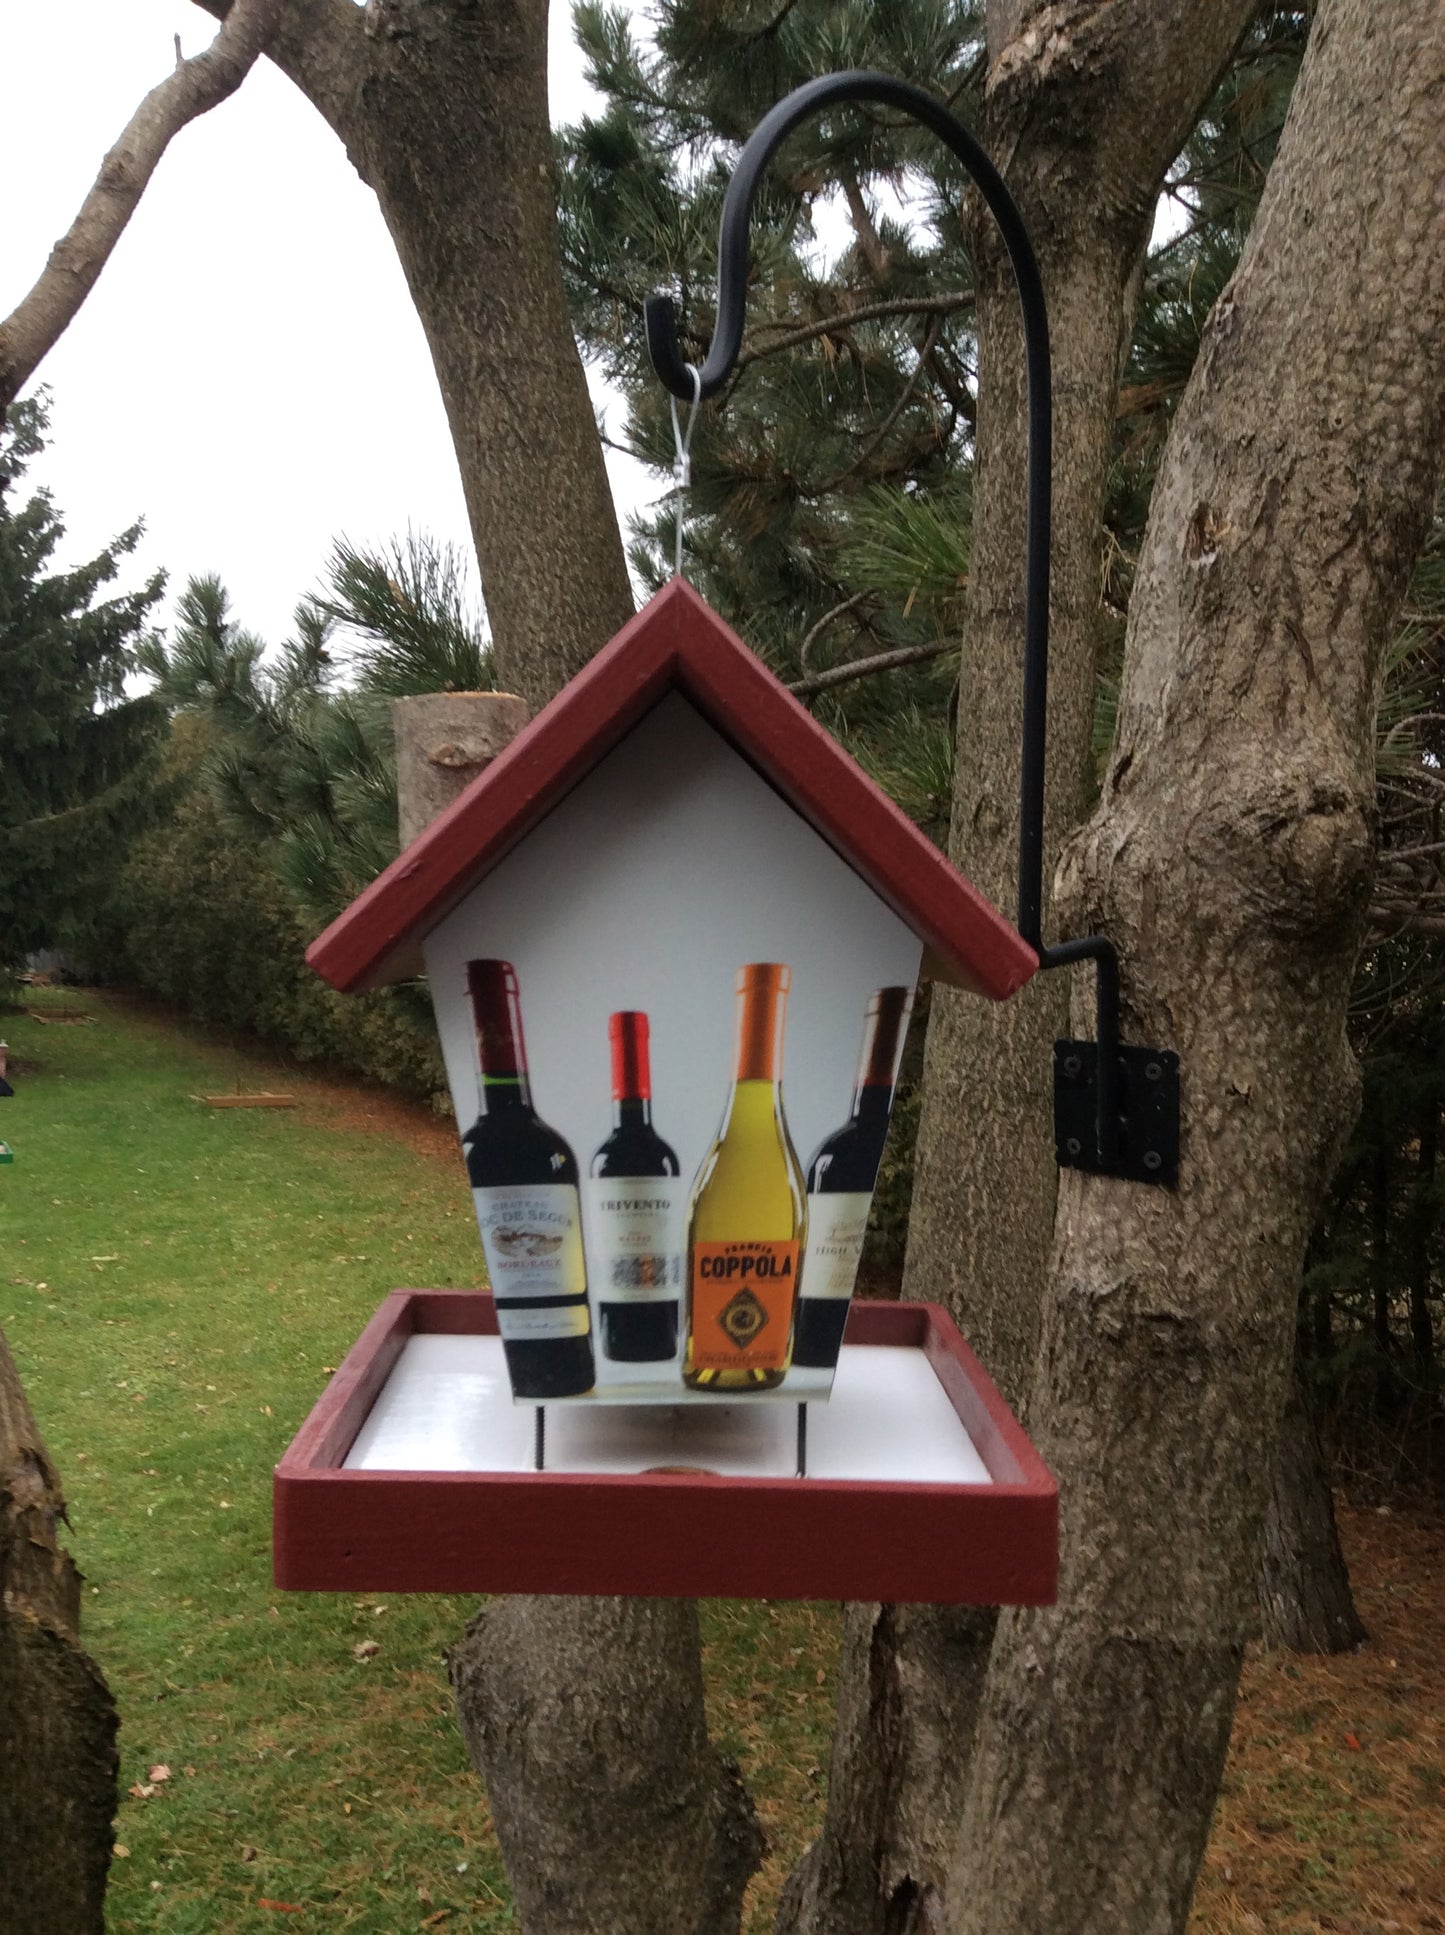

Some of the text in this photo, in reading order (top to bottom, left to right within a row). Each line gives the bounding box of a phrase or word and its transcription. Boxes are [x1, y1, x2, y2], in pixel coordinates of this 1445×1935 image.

[600, 1199, 671, 1211] TRIVENTO
[502, 1210, 525, 1222] DE
[700, 1255, 791, 1278] COPPOLA
